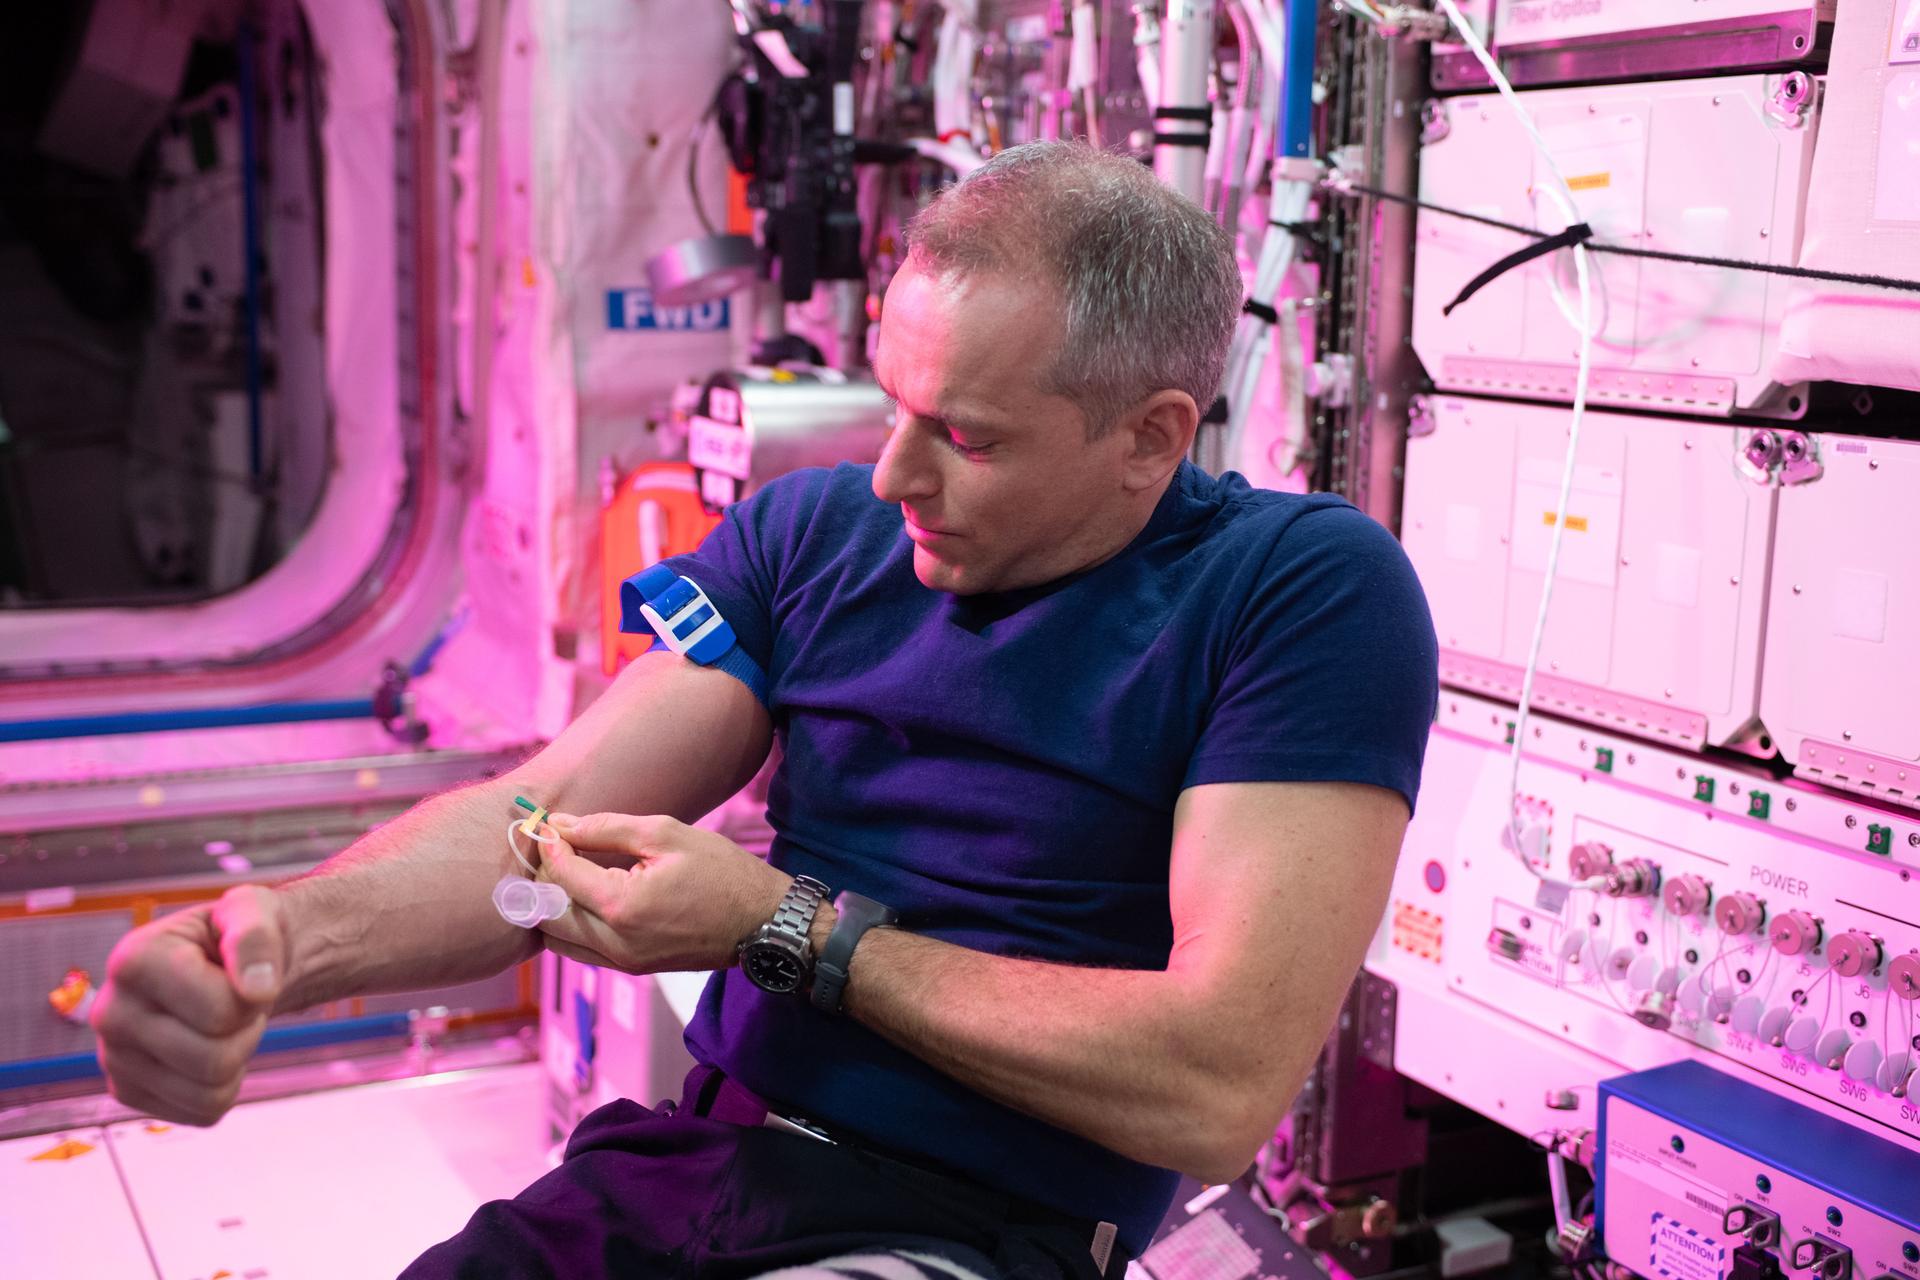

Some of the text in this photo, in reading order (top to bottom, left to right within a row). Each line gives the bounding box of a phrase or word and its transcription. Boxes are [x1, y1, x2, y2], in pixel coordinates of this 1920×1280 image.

[623, 292, 725, 329] FWD
[1750, 865, 1809, 898] POWER
[1796, 963, 1811, 977] J5
[1855, 983, 1870, 999] J6
[1780, 1054, 1807, 1077] SW5
[1839, 1079, 1867, 1102] SW6
[1900, 1104, 1920, 1124] SW
[1676, 1154, 1697, 1169] POWER
[1802, 1225, 1812, 1235] ON
[1826, 1226, 1841, 1238] SW2
[1660, 1226, 1715, 1262] ATTENTION
[1876, 1260, 1887, 1270] ON
[1903, 1262, 1918, 1275] SW3
